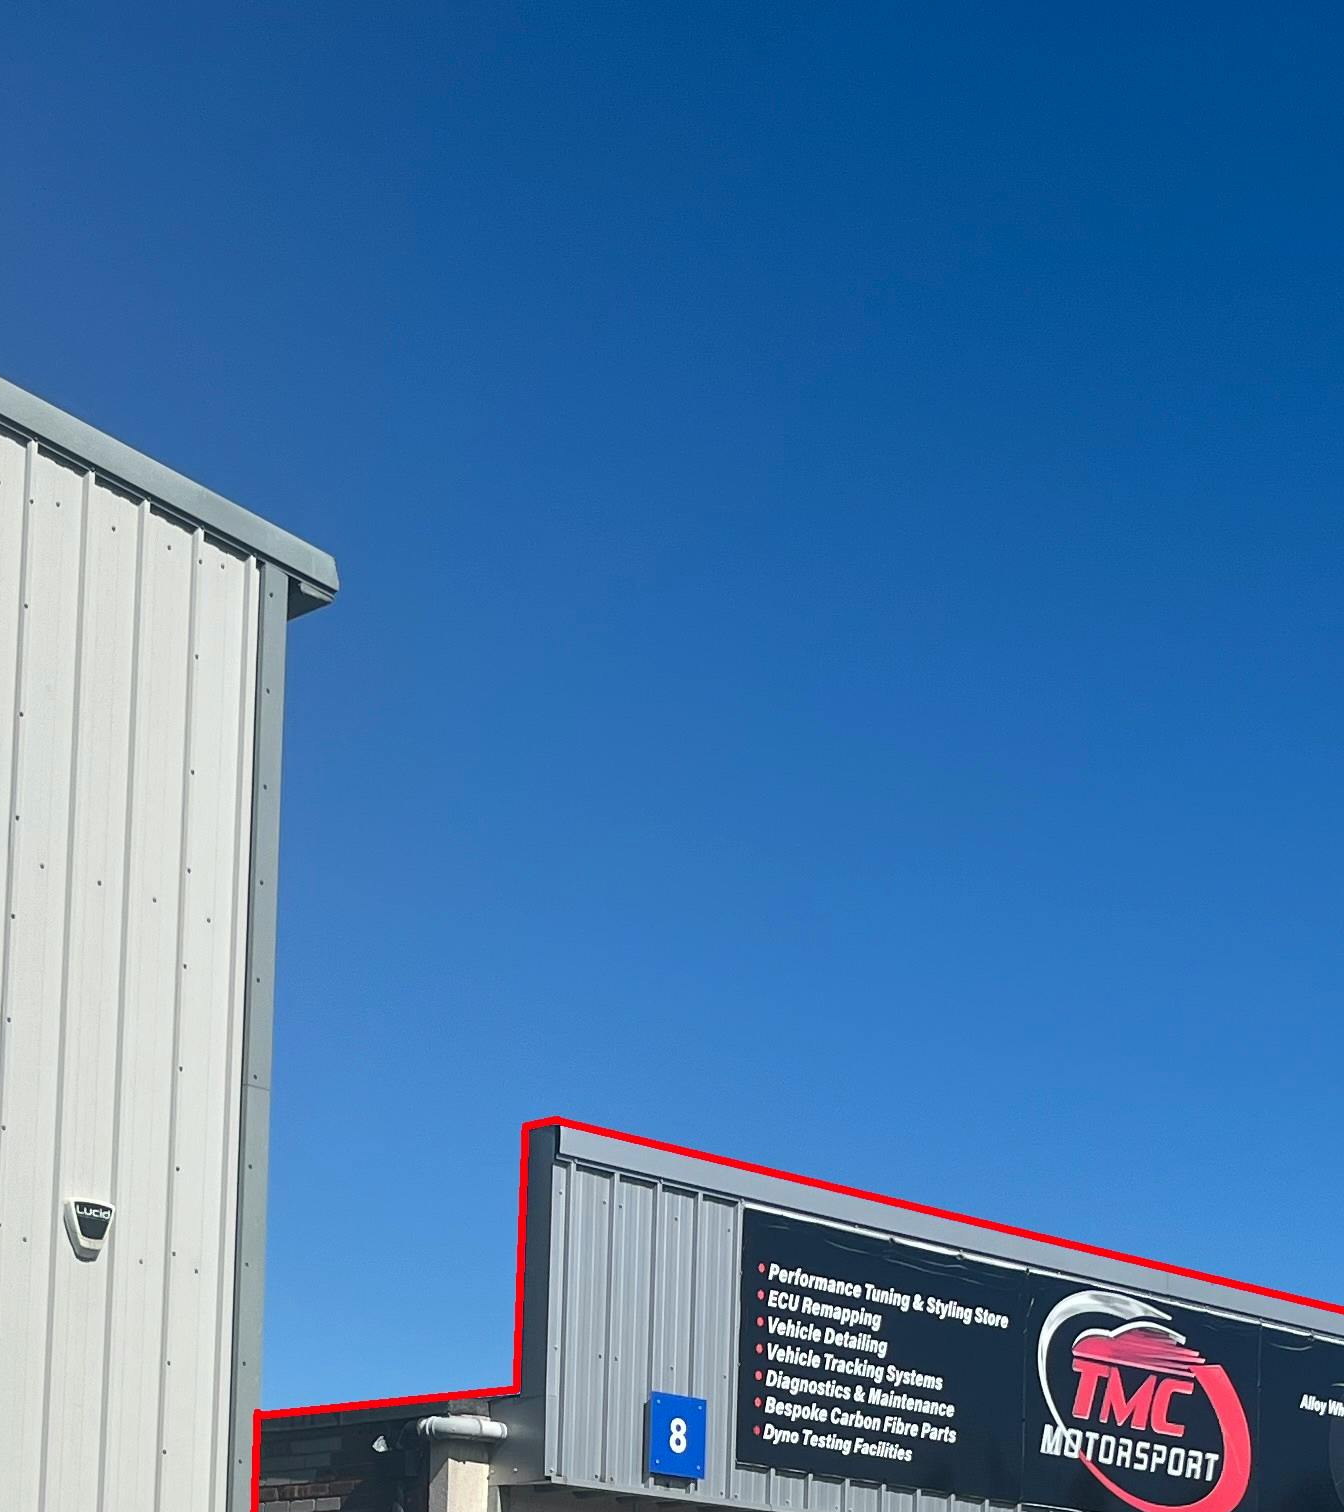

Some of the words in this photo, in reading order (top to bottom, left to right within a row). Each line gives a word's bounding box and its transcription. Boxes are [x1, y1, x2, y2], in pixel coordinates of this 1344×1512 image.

[76, 1204, 111, 1219] Lucid
[767, 1290, 800, 1311] ECU
[801, 1297, 882, 1331] Remapping
[768, 1263, 862, 1298] Performance
[865, 1283, 910, 1312] Tuning
[912, 1294, 924, 1311] &
[926, 1297, 972, 1324] Styling
[974, 1307, 1009, 1328] Store
[767, 1316, 822, 1342] Vehicle
[824, 1327, 888, 1358] Detailing
[767, 1342, 821, 1368] Vehicle
[824, 1353, 884, 1383] Tracking
[886, 1365, 943, 1390] Systems
[766, 1369, 851, 1400] Diagnostics
[853, 1385, 866, 1402] &
[868, 1387, 955, 1417] Maintenance
[1071, 1357, 1194, 1437] TMC
[1299, 1394, 1327, 1415] Alloy
[669, 1417, 687, 1454] 8
[764, 1396, 828, 1422] Bespoke
[830, 1407, 881, 1431] Carbon
[883, 1416, 919, 1437] Fibre
[920, 1422, 957, 1443] Parts
[763, 1423, 799, 1444] Dyno
[802, 1429, 852, 1455] Testing
[853, 1437, 913, 1461] Facilities
[1040, 1424, 1220, 1482] MOTORSPORT
